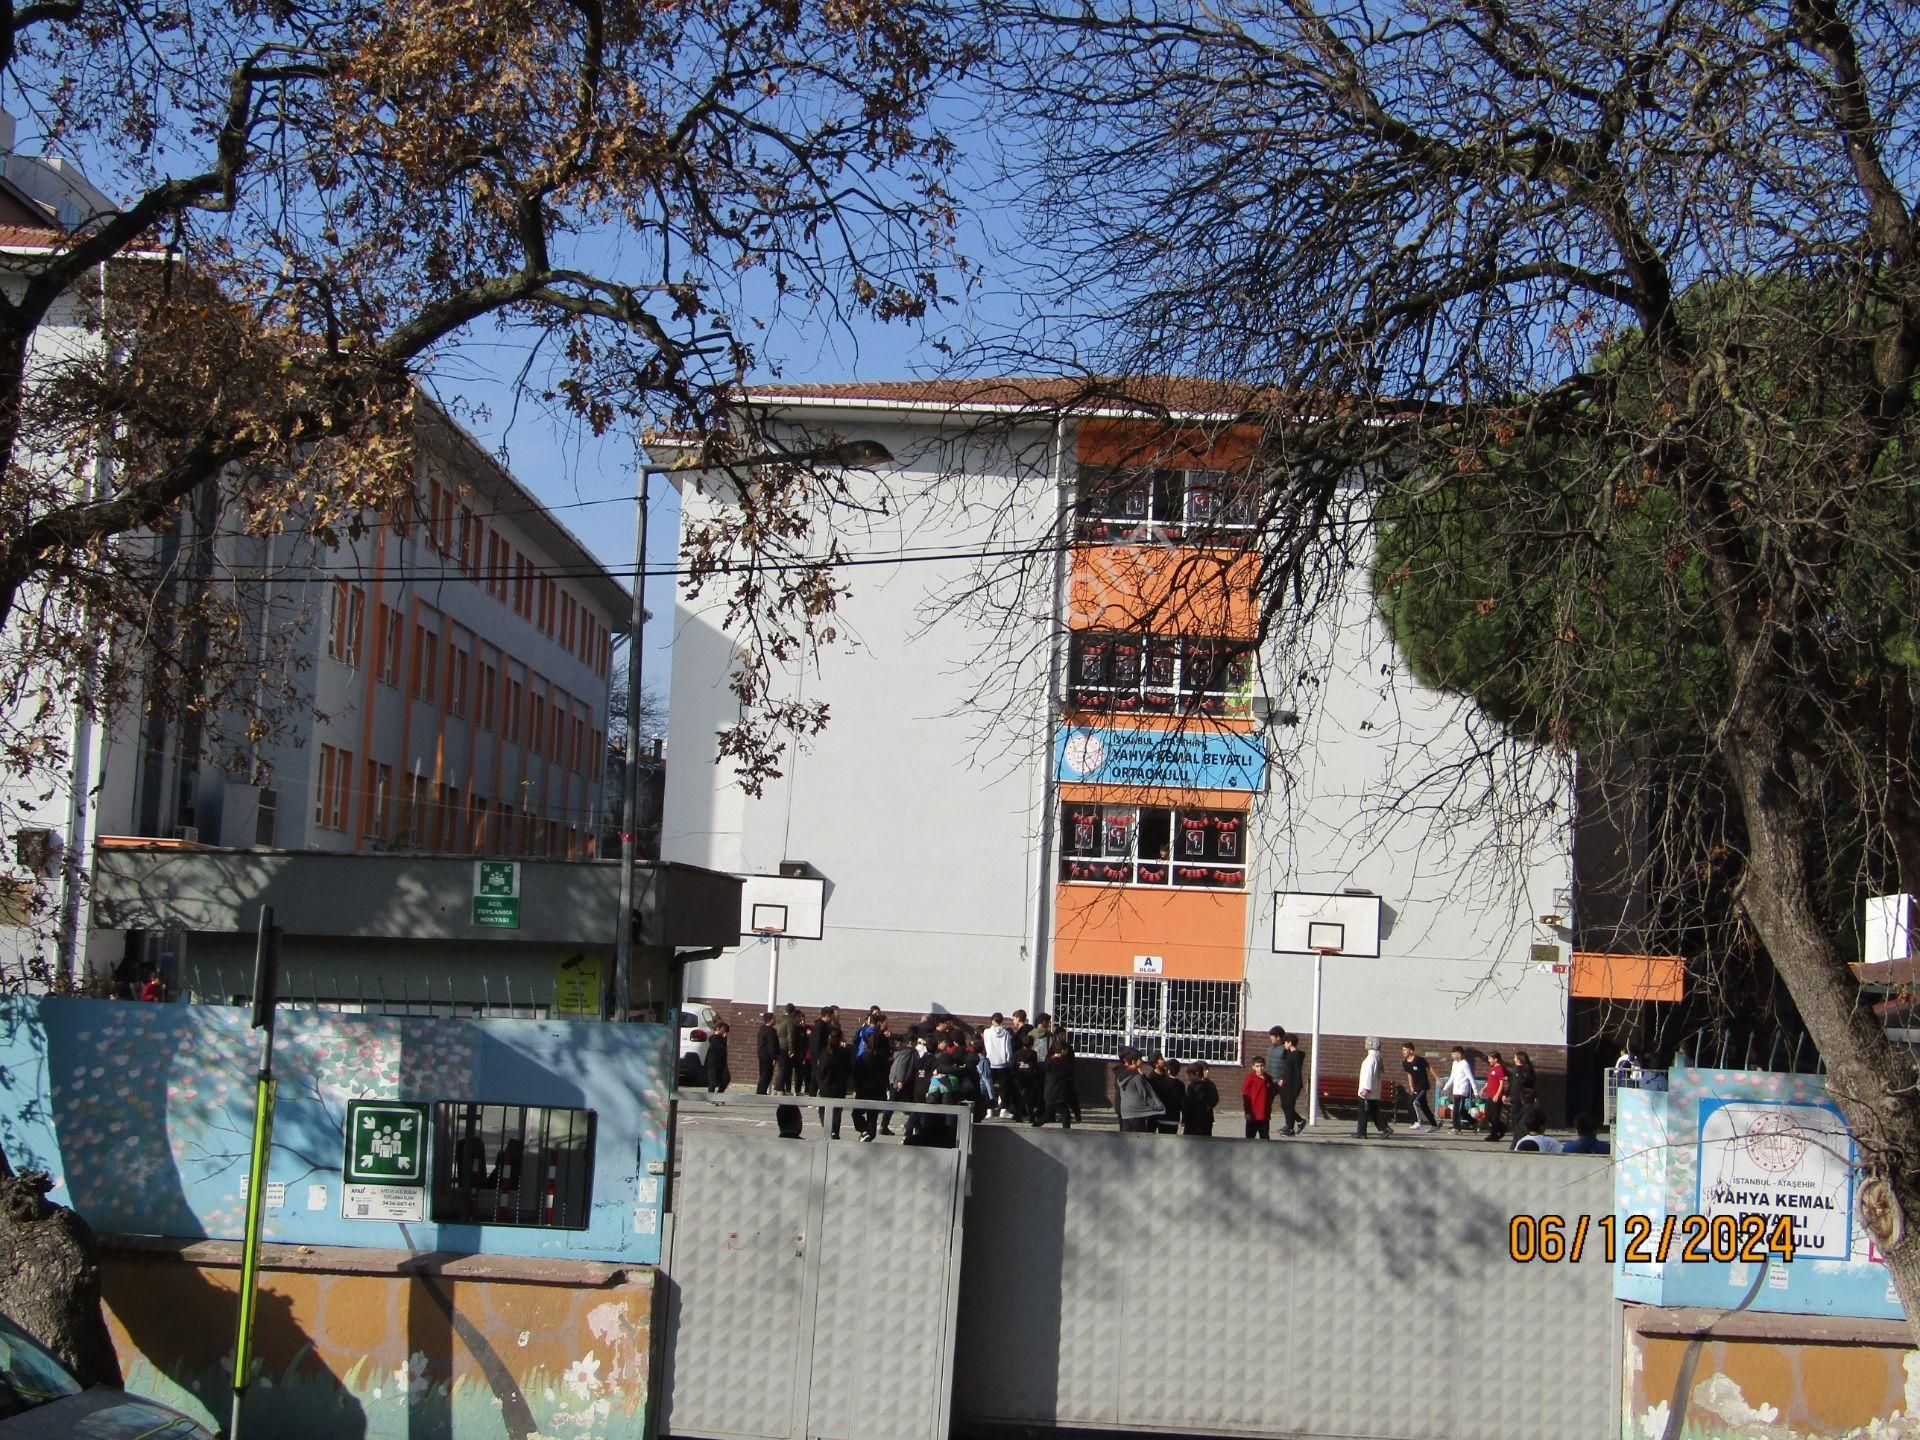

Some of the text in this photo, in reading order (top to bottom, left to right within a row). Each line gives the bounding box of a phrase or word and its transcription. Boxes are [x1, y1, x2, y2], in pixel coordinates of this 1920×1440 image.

[1113, 749, 1252, 766] YAHYA KEMAL BEYATLI
[1112, 766, 1189, 781] ORTAOKULU
[1144, 957, 1152, 966] A
[1733, 1176, 1770, 1186] İSTANBUL
[1778, 1180, 1816, 1189] ATAŞEHİR
[1714, 1190, 1835, 1210] YAHYA KEMAL
[1739, 1211, 1808, 1228] BYALI
[1720, 1230, 1825, 1248] OAULU
